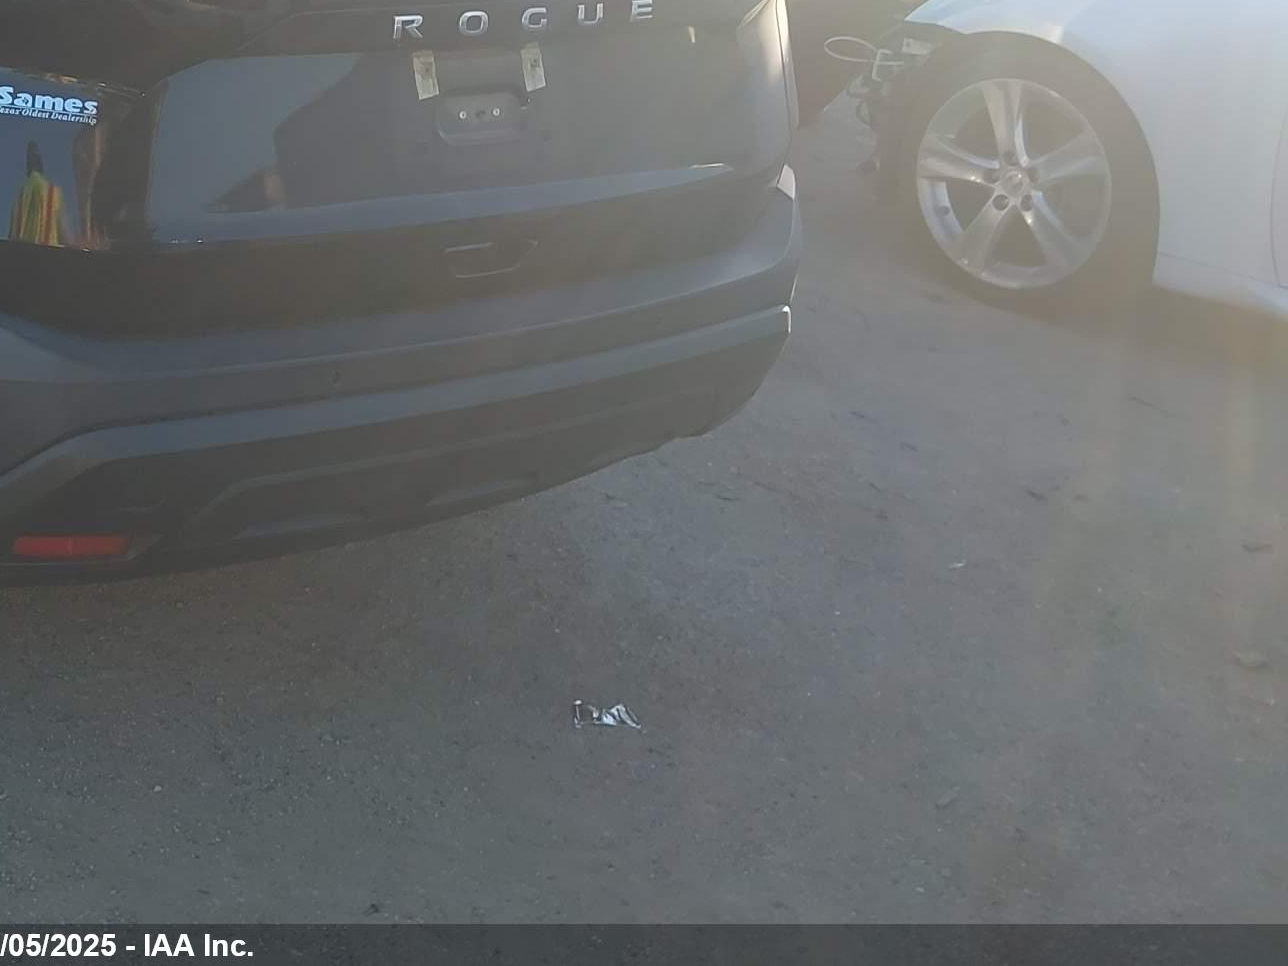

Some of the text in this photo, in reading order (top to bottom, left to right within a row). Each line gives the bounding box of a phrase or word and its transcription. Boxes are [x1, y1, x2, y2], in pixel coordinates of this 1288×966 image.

[393, 0, 654, 40] ROGUE
[22, 107, 50, 119] Oldest
[51, 111, 97, 126] Dealership
